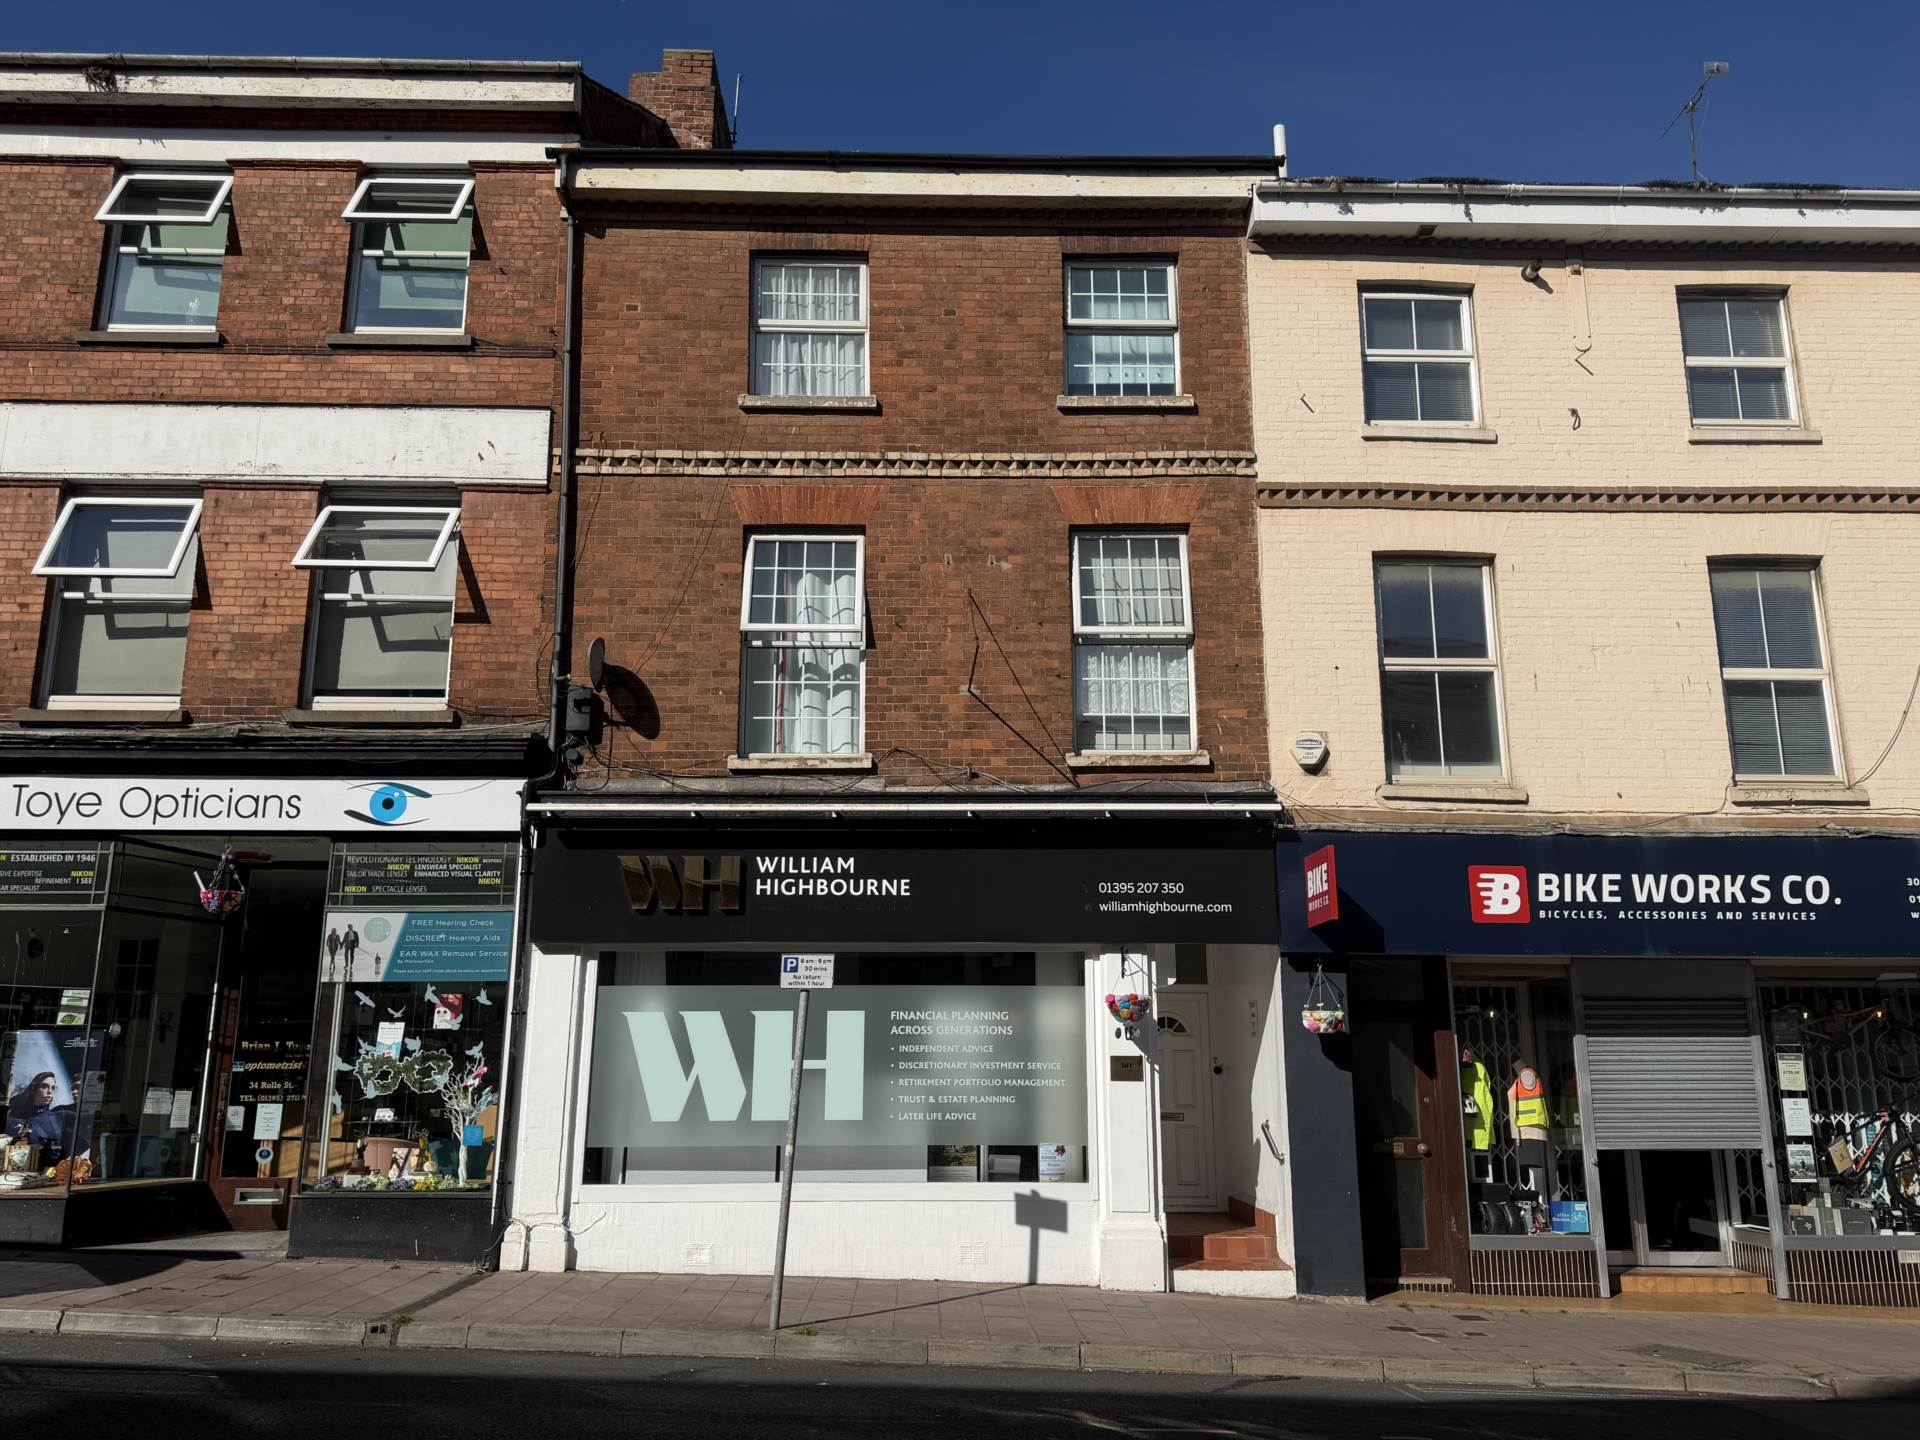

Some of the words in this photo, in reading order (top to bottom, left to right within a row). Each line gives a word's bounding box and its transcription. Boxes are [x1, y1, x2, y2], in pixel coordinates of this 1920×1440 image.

[12, 784, 102, 825] Toye
[119, 786, 302, 825] Opticians
[10, 854, 63, 862] ESTABLISHED
[64, 854, 74, 862] IN
[76, 854, 96, 862] 1946
[405, 856, 451, 864] TECHNOLOGY
[756, 856, 855, 874] WILLIAM
[13, 870, 43, 878] EXPERTISE
[1307, 862, 1329, 898] BIKE
[756, 878, 912, 897] HIGHBOURNE
[1098, 882, 1135, 894] 01395
[1136, 882, 1159, 894] 207
[1161, 882, 1185, 894] 350
[1538, 873, 1622, 903] BIKE
[1631, 874, 1772, 904] WORKS
[1782, 874, 1842, 905] CO.
[1099, 901, 1233, 914] williamhighbourne.com
[1539, 910, 1607, 920] BICYCLES,
[1618, 911, 1708, 920] ACCESSORIES
[1716, 911, 1743, 920] AND
[1752, 911, 1817, 921] SERVICES
[435, 919, 467, 927] Hearing
[786, 958, 797, 972] P
[890, 1011, 948, 1021] FINANCIAL
[951, 1011, 1009, 1021] PLANNING
[890, 1025, 933, 1035] ACROSS
[936, 1025, 1013, 1035] GENERATIONS
[241, 1041, 271, 1050] Brian
[899, 1045, 960, 1053] INDEPENDENT
[962, 1045, 994, 1053] ADVICE
[245, 1060, 303, 1071] optometrist
[621, 1010, 866, 1122] WH
[899, 1062, 967, 1070] DISCRETIONARY
[970, 1062, 1025, 1070] INVESTMENT
[1027, 1062, 1062, 1070] SERVICE
[899, 1078, 951, 1086] RETIREMENT
[954, 1078, 1002, 1086] PORTFOLIO
[1004, 1078, 1066, 1087] MANAGEMENT
